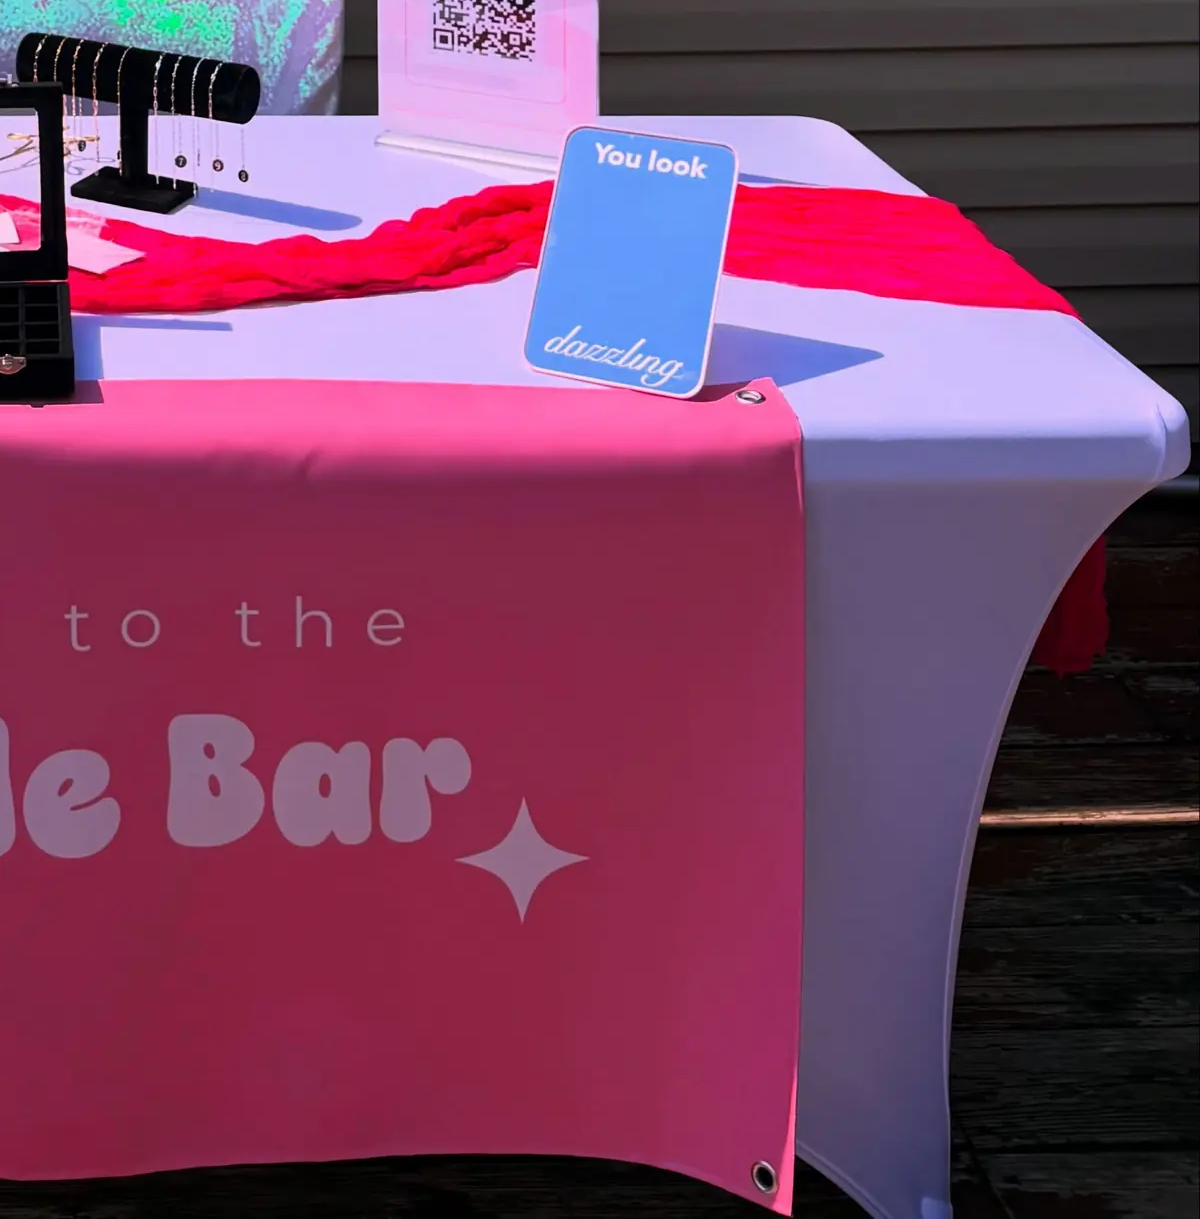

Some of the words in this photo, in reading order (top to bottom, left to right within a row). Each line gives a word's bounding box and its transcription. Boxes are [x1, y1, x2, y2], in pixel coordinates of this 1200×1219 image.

[595, 142, 642, 169] You
[648, 149, 708, 179] look
[543, 325, 684, 388] dazzling
[64, 606, 160, 651] to
[235, 596, 405, 648] the
[167, 714, 472, 847] Bar
